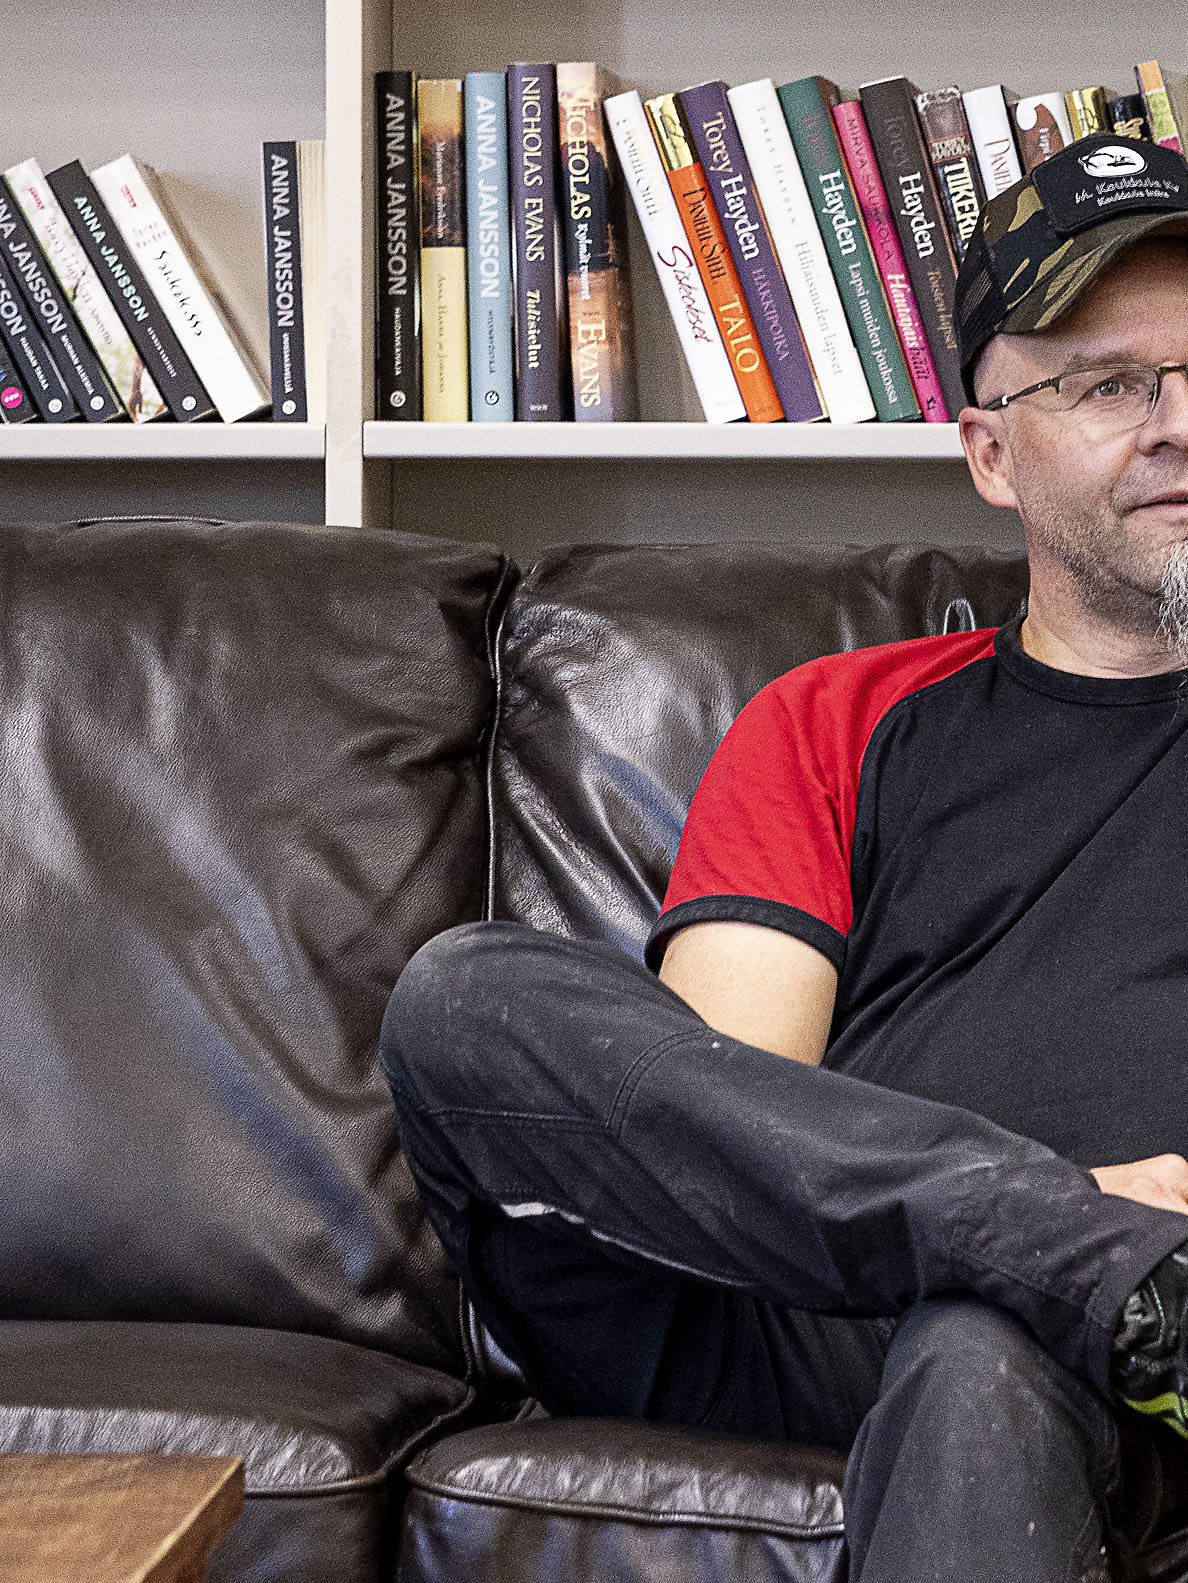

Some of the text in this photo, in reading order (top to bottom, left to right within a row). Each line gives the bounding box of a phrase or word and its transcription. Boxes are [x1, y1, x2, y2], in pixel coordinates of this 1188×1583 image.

[385, 94, 405, 169] ANNA
[475, 95, 496, 173] ANNA
[563, 87, 594, 220] NICHOLAS
[271, 154, 289, 220] ANNA
[521, 77, 545, 368] NICHOLAS EVANS Tulisielut
[683, 187, 720, 250] DANIELLE
[701, 111, 734, 174] Torey
[720, 174, 760, 261] Hayden
[818, 171, 857, 256] Hayden
[899, 171, 936, 258] Hayden
[74, 197, 106, 243] ANNA
[101, 243, 148, 321] JANSSON
[273, 226, 294, 327] JANSSON
[386, 179, 408, 296] JANSSON
[477, 179, 499, 299] JANSSON
[848, 262, 869, 298] Lapsi
[9, 241, 66, 334] JANSSON
[859, 298, 883, 348] muiden
[20, 337, 49, 391] HAUDAN TAKAA
[576, 319, 609, 408] EVANS
[719, 295, 760, 374] TALO
[870, 348, 898, 404] joukossa
